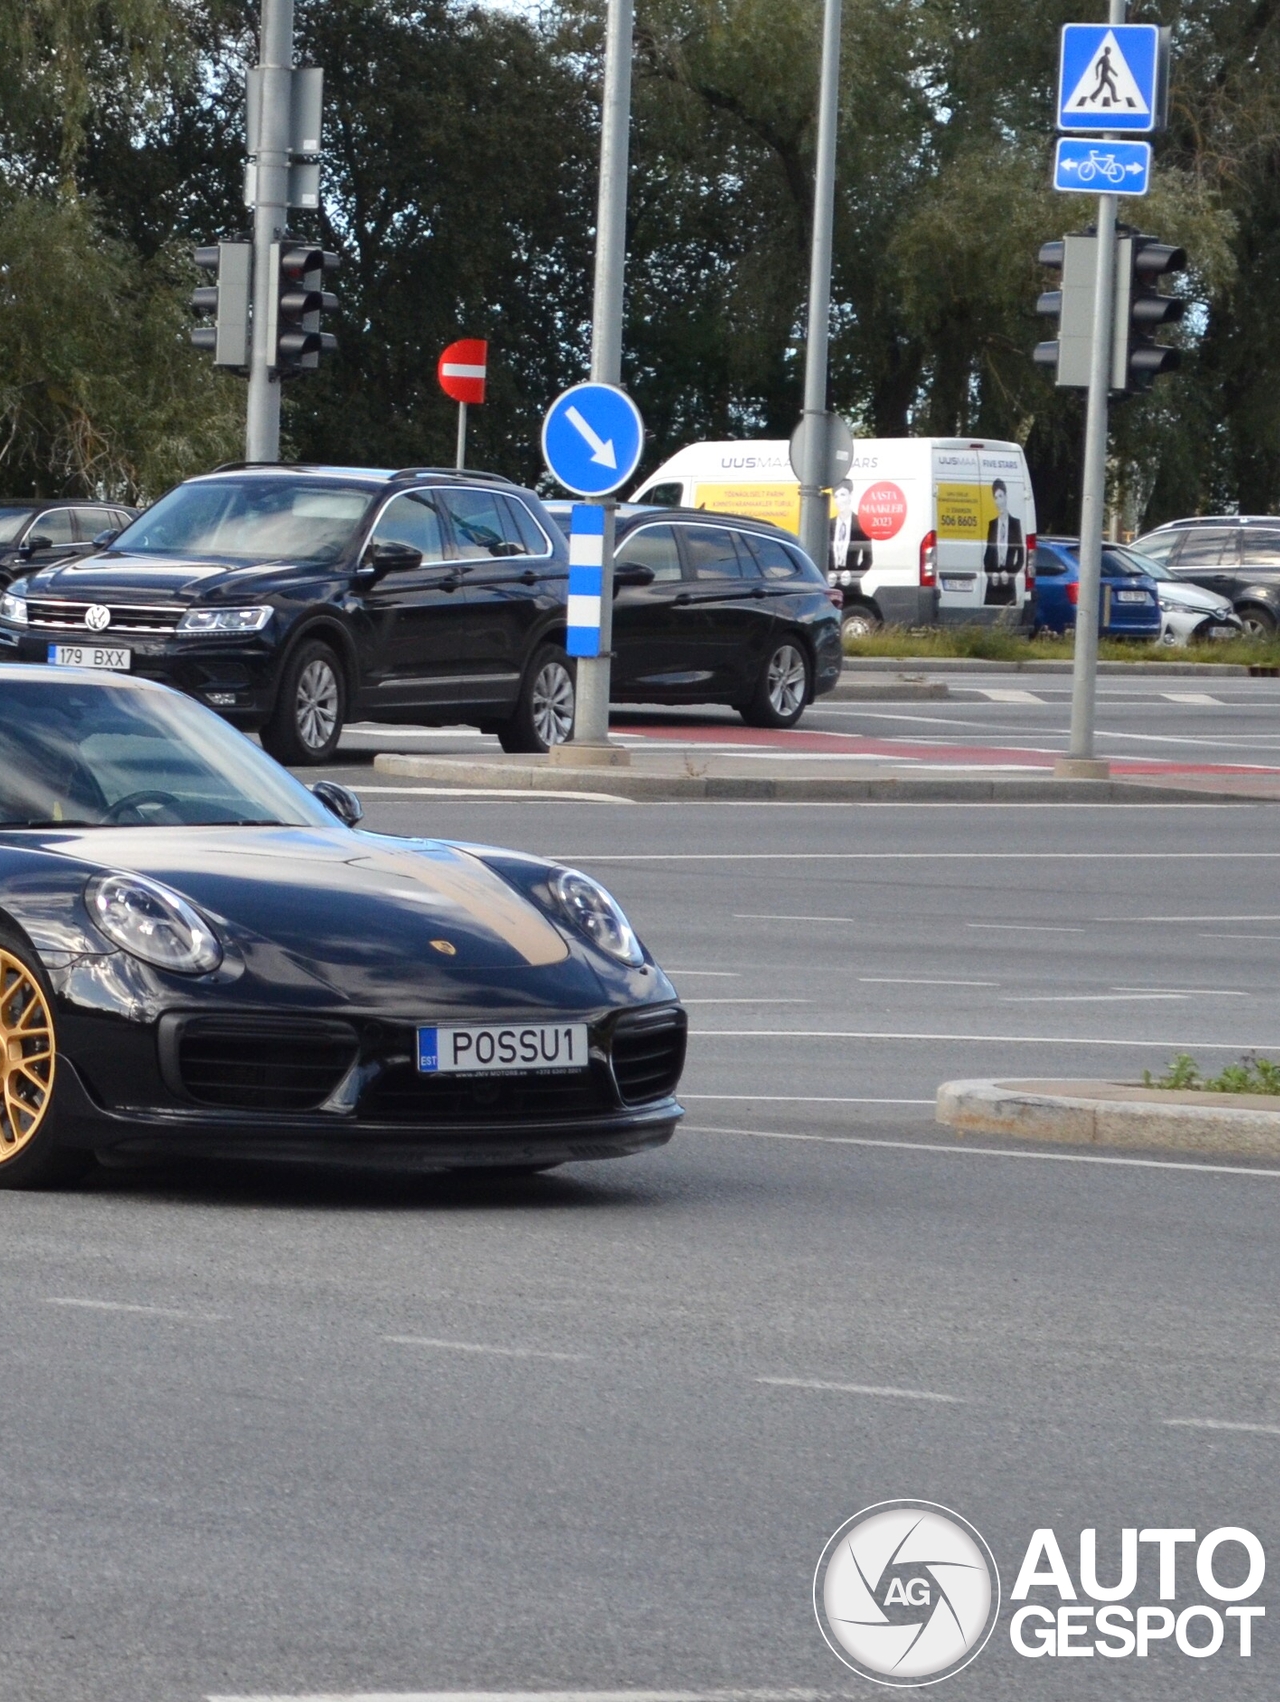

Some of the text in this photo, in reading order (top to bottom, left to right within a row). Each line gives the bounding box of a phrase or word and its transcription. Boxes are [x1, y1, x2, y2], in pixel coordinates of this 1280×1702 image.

[871, 491, 898, 501] AASTA
[861, 503, 904, 514] MAAKLER
[871, 516, 893, 527] 2023
[940, 515, 978, 527] 506 8605
[60, 648, 125, 667] 179 BXX
[452, 1028, 574, 1065] POSSU1
[421, 1055, 437, 1066] EST
